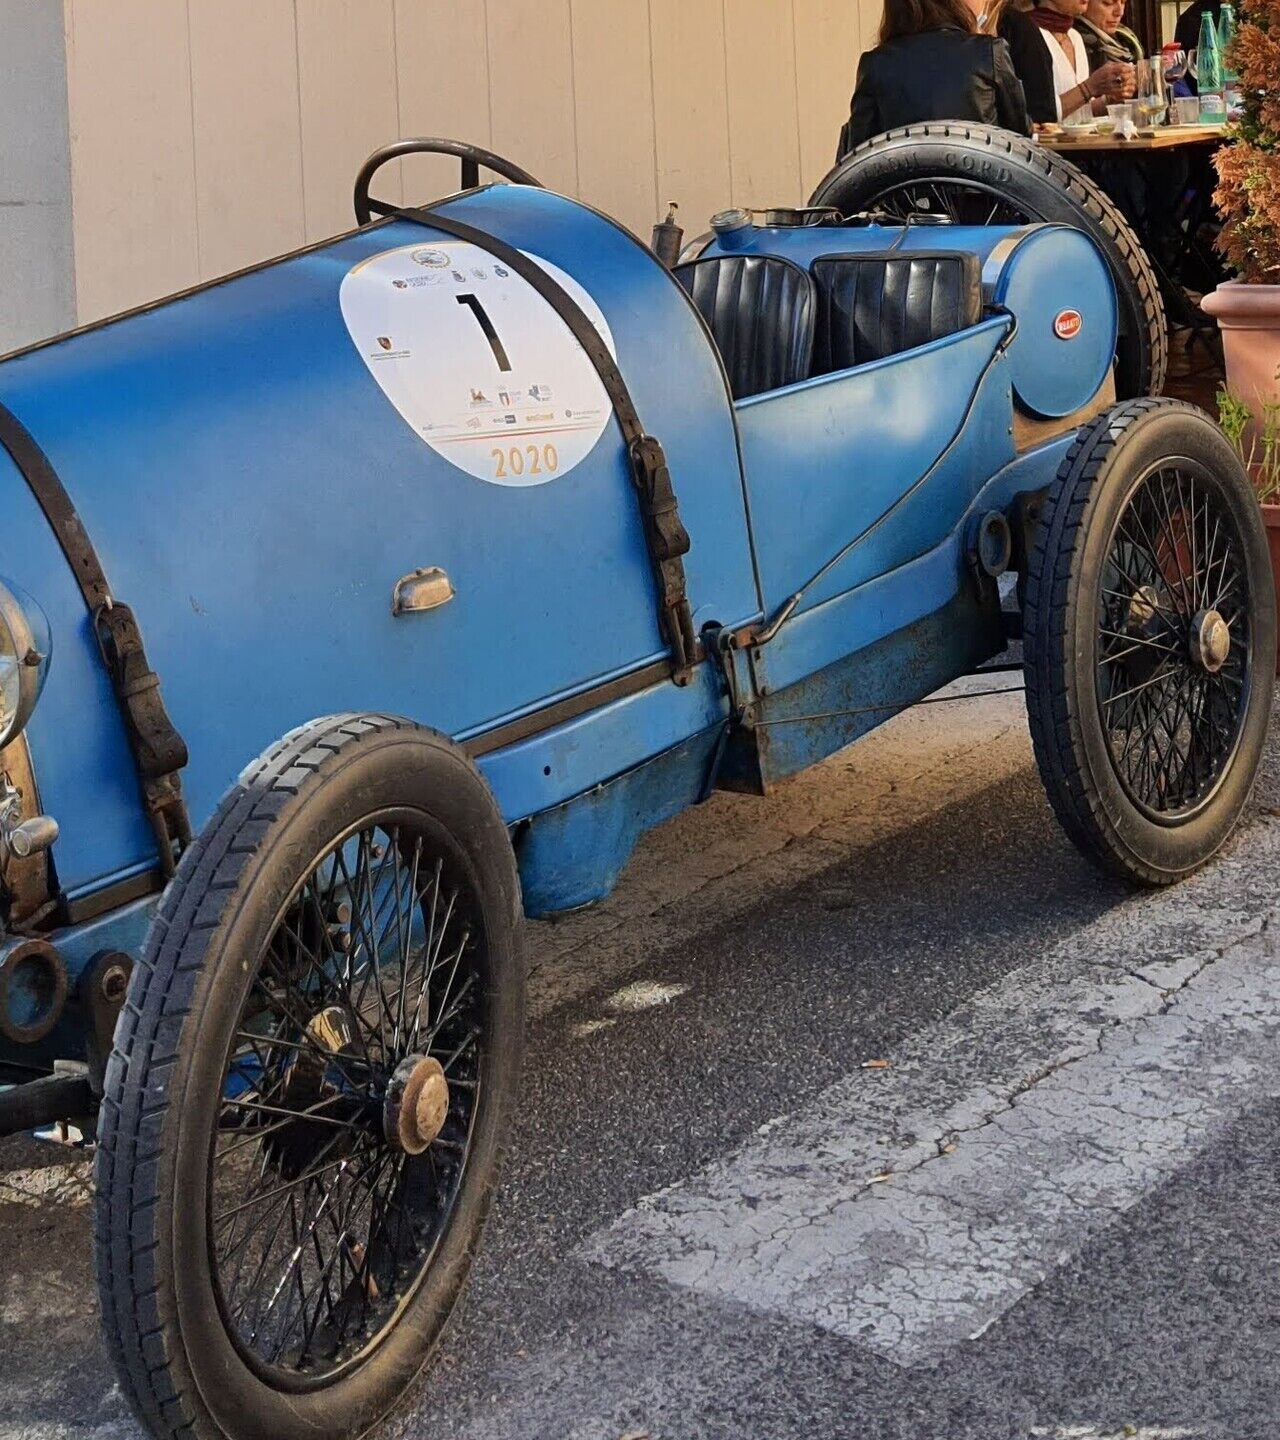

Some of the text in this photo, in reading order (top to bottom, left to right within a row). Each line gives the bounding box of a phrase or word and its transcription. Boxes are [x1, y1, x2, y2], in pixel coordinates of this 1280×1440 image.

[943, 150, 1014, 183] CORD
[455, 293, 512, 373] 1
[490, 443, 559, 478] 2020
